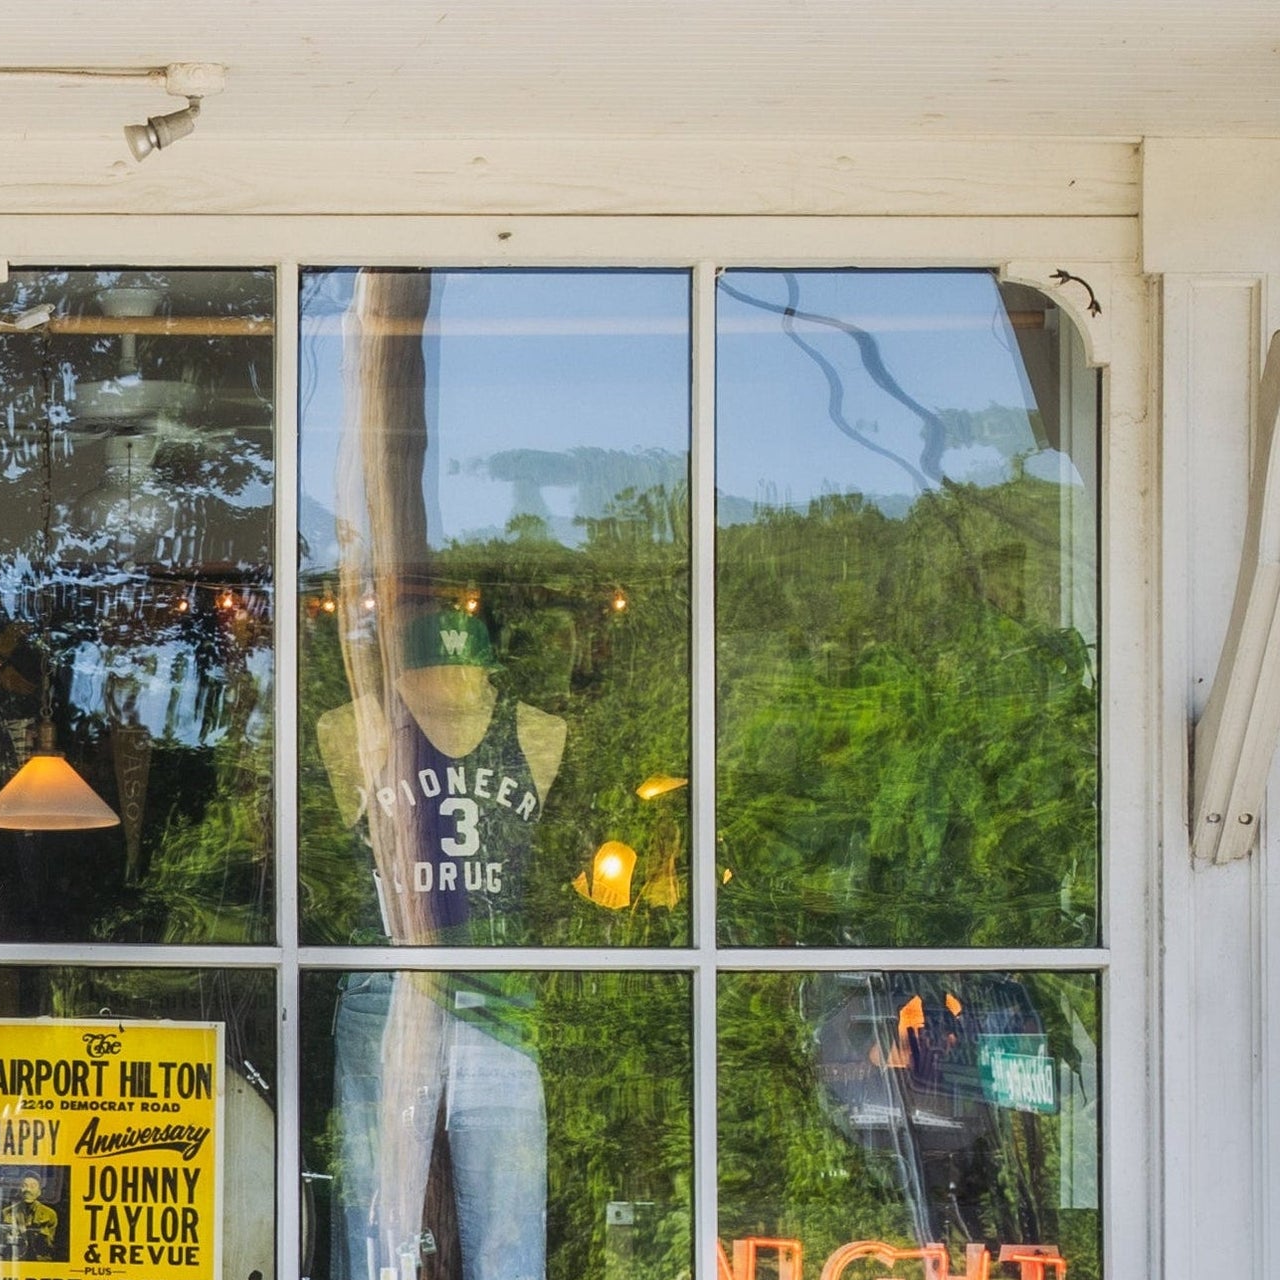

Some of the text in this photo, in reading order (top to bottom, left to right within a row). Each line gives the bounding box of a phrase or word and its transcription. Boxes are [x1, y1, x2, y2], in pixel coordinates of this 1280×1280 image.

[439, 630, 468, 655] W
[376, 767, 539, 822] PIONEER
[440, 797, 480, 857] 3
[413, 862, 502, 893] DRUG
[82, 1033, 122, 1058] The
[120, 1061, 212, 1099] HILTON
[21, 1100, 181, 1112] 2240 DEMOCRAT ROAD
[74, 1116, 210, 1161] Anniversary
[83, 1165, 201, 1204] JOHNNY
[84, 1205, 199, 1244] TAYLOR
[84, 1245, 200, 1266] & REVUE
